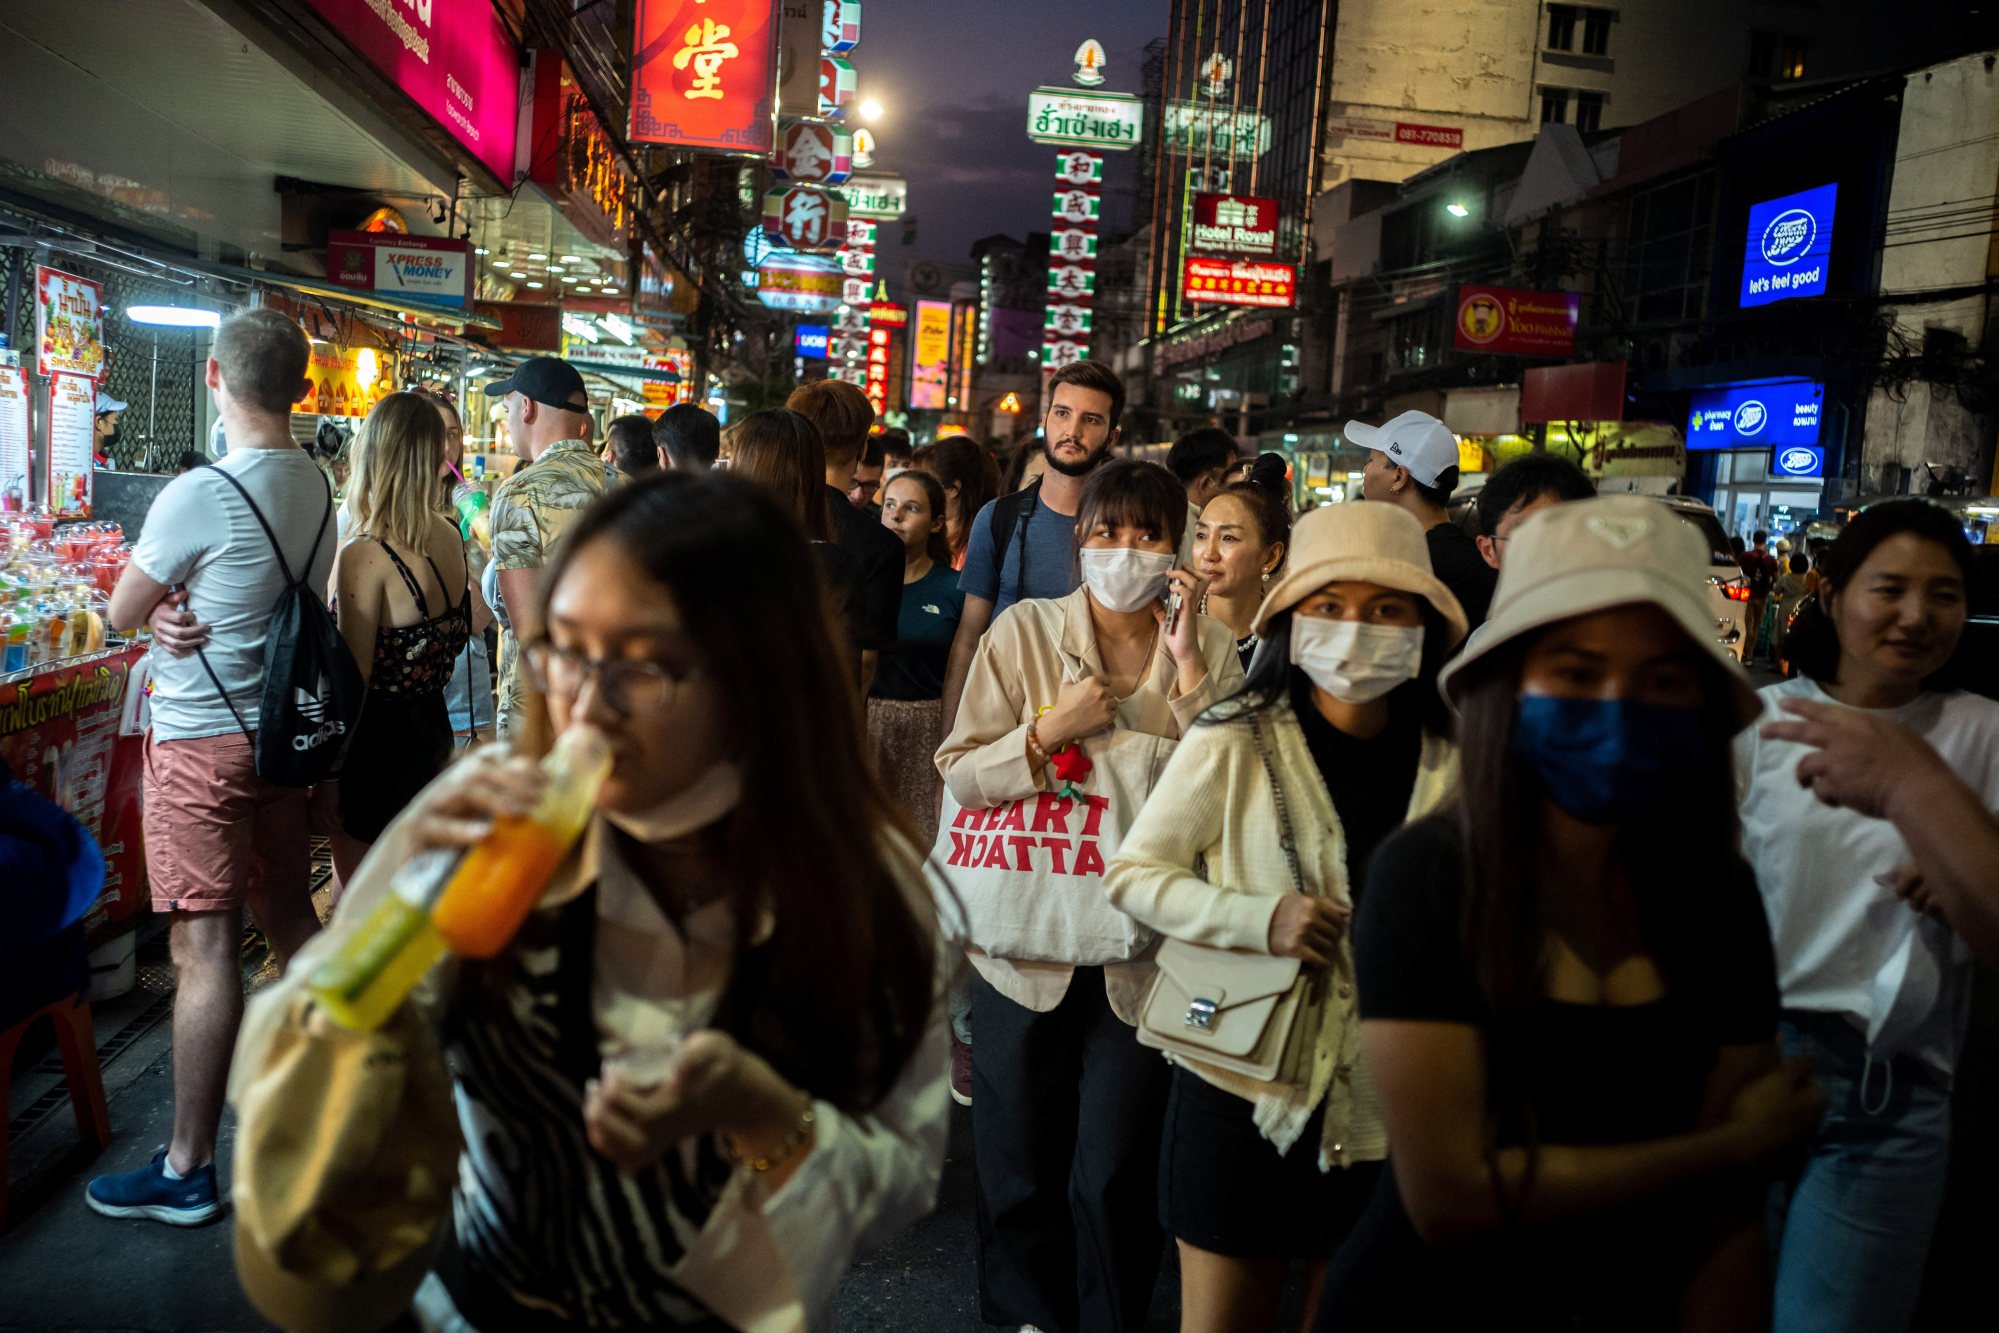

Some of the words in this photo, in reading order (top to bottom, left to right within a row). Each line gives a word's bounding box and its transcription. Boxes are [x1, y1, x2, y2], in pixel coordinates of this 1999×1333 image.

[673, 0, 739, 100] 堂
[1195, 224, 1232, 240] Hotel
[1233, 227, 1275, 245] Royal
[369, 237, 397, 246] Currency
[397, 239, 427, 249] Exchange
[386, 253, 443, 267] XPRESS
[402, 265, 453, 279] MONEY
[1749, 277, 1770, 294] let's
[1772, 272, 1791, 291] feel
[1792, 266, 1820, 289] good
[801, 334, 827, 348] UOB
[1704, 409, 1732, 422] pharmacy
[1795, 402, 1819, 415] beauty
[1738, 406, 1763, 430] Boots
[1784, 451, 1812, 469] Boots
[951, 792, 1110, 837] HEART
